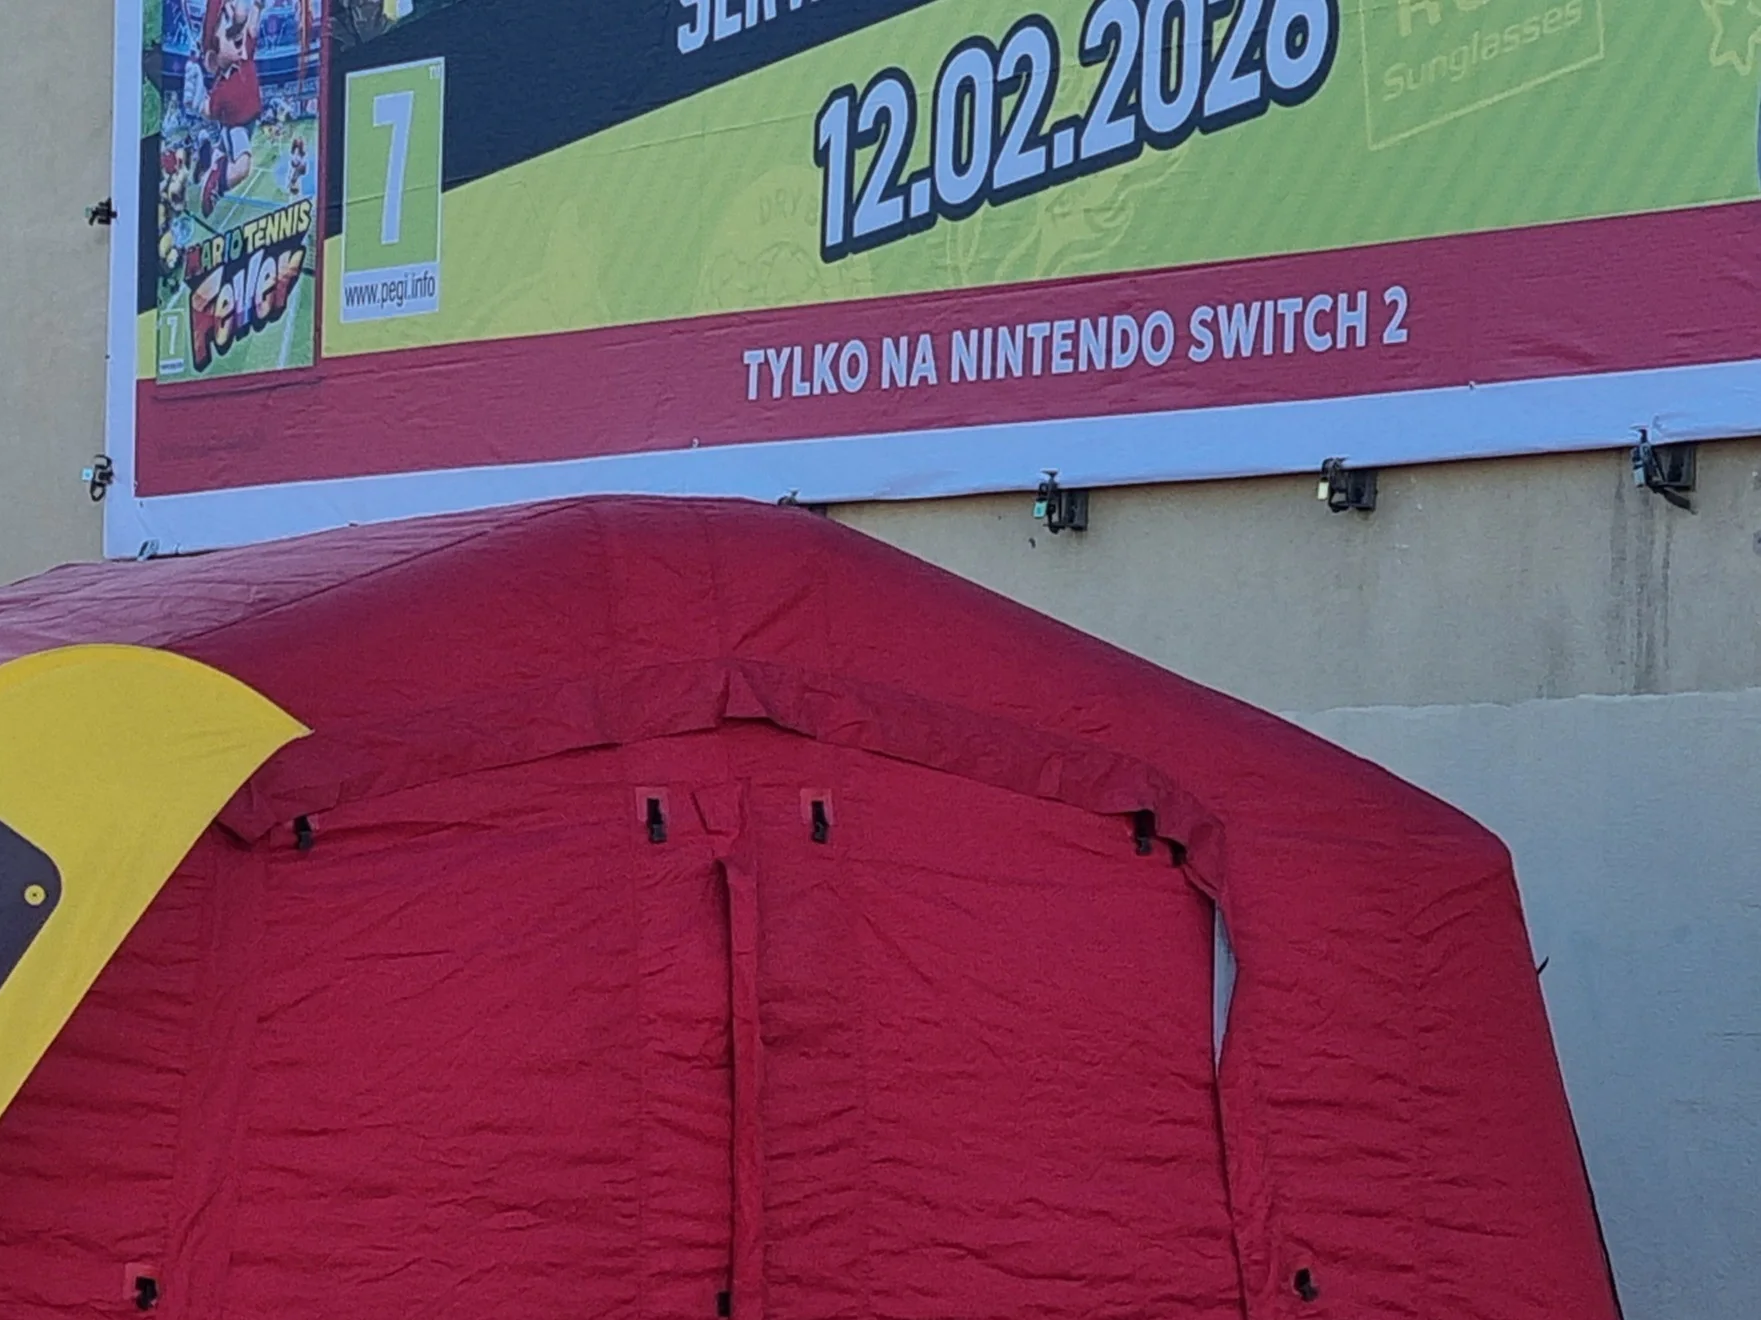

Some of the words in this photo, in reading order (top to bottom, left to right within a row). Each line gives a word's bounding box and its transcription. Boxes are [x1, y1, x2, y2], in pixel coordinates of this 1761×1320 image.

[1382, 1, 1584, 101] Sunglasses
[372, 91, 413, 245] 7
[816, 0, 1333, 253] 12.02.2026
[184, 230, 240, 279] MARIO
[243, 200, 312, 254] TENNIS
[344, 271, 436, 308] www.pegi.info
[743, 339, 869, 400] TYLKO
[881, 333, 938, 389] NA
[950, 310, 1174, 383] NINTENDO
[1188, 290, 1368, 363] SWITCH
[1383, 285, 1409, 344] 2
